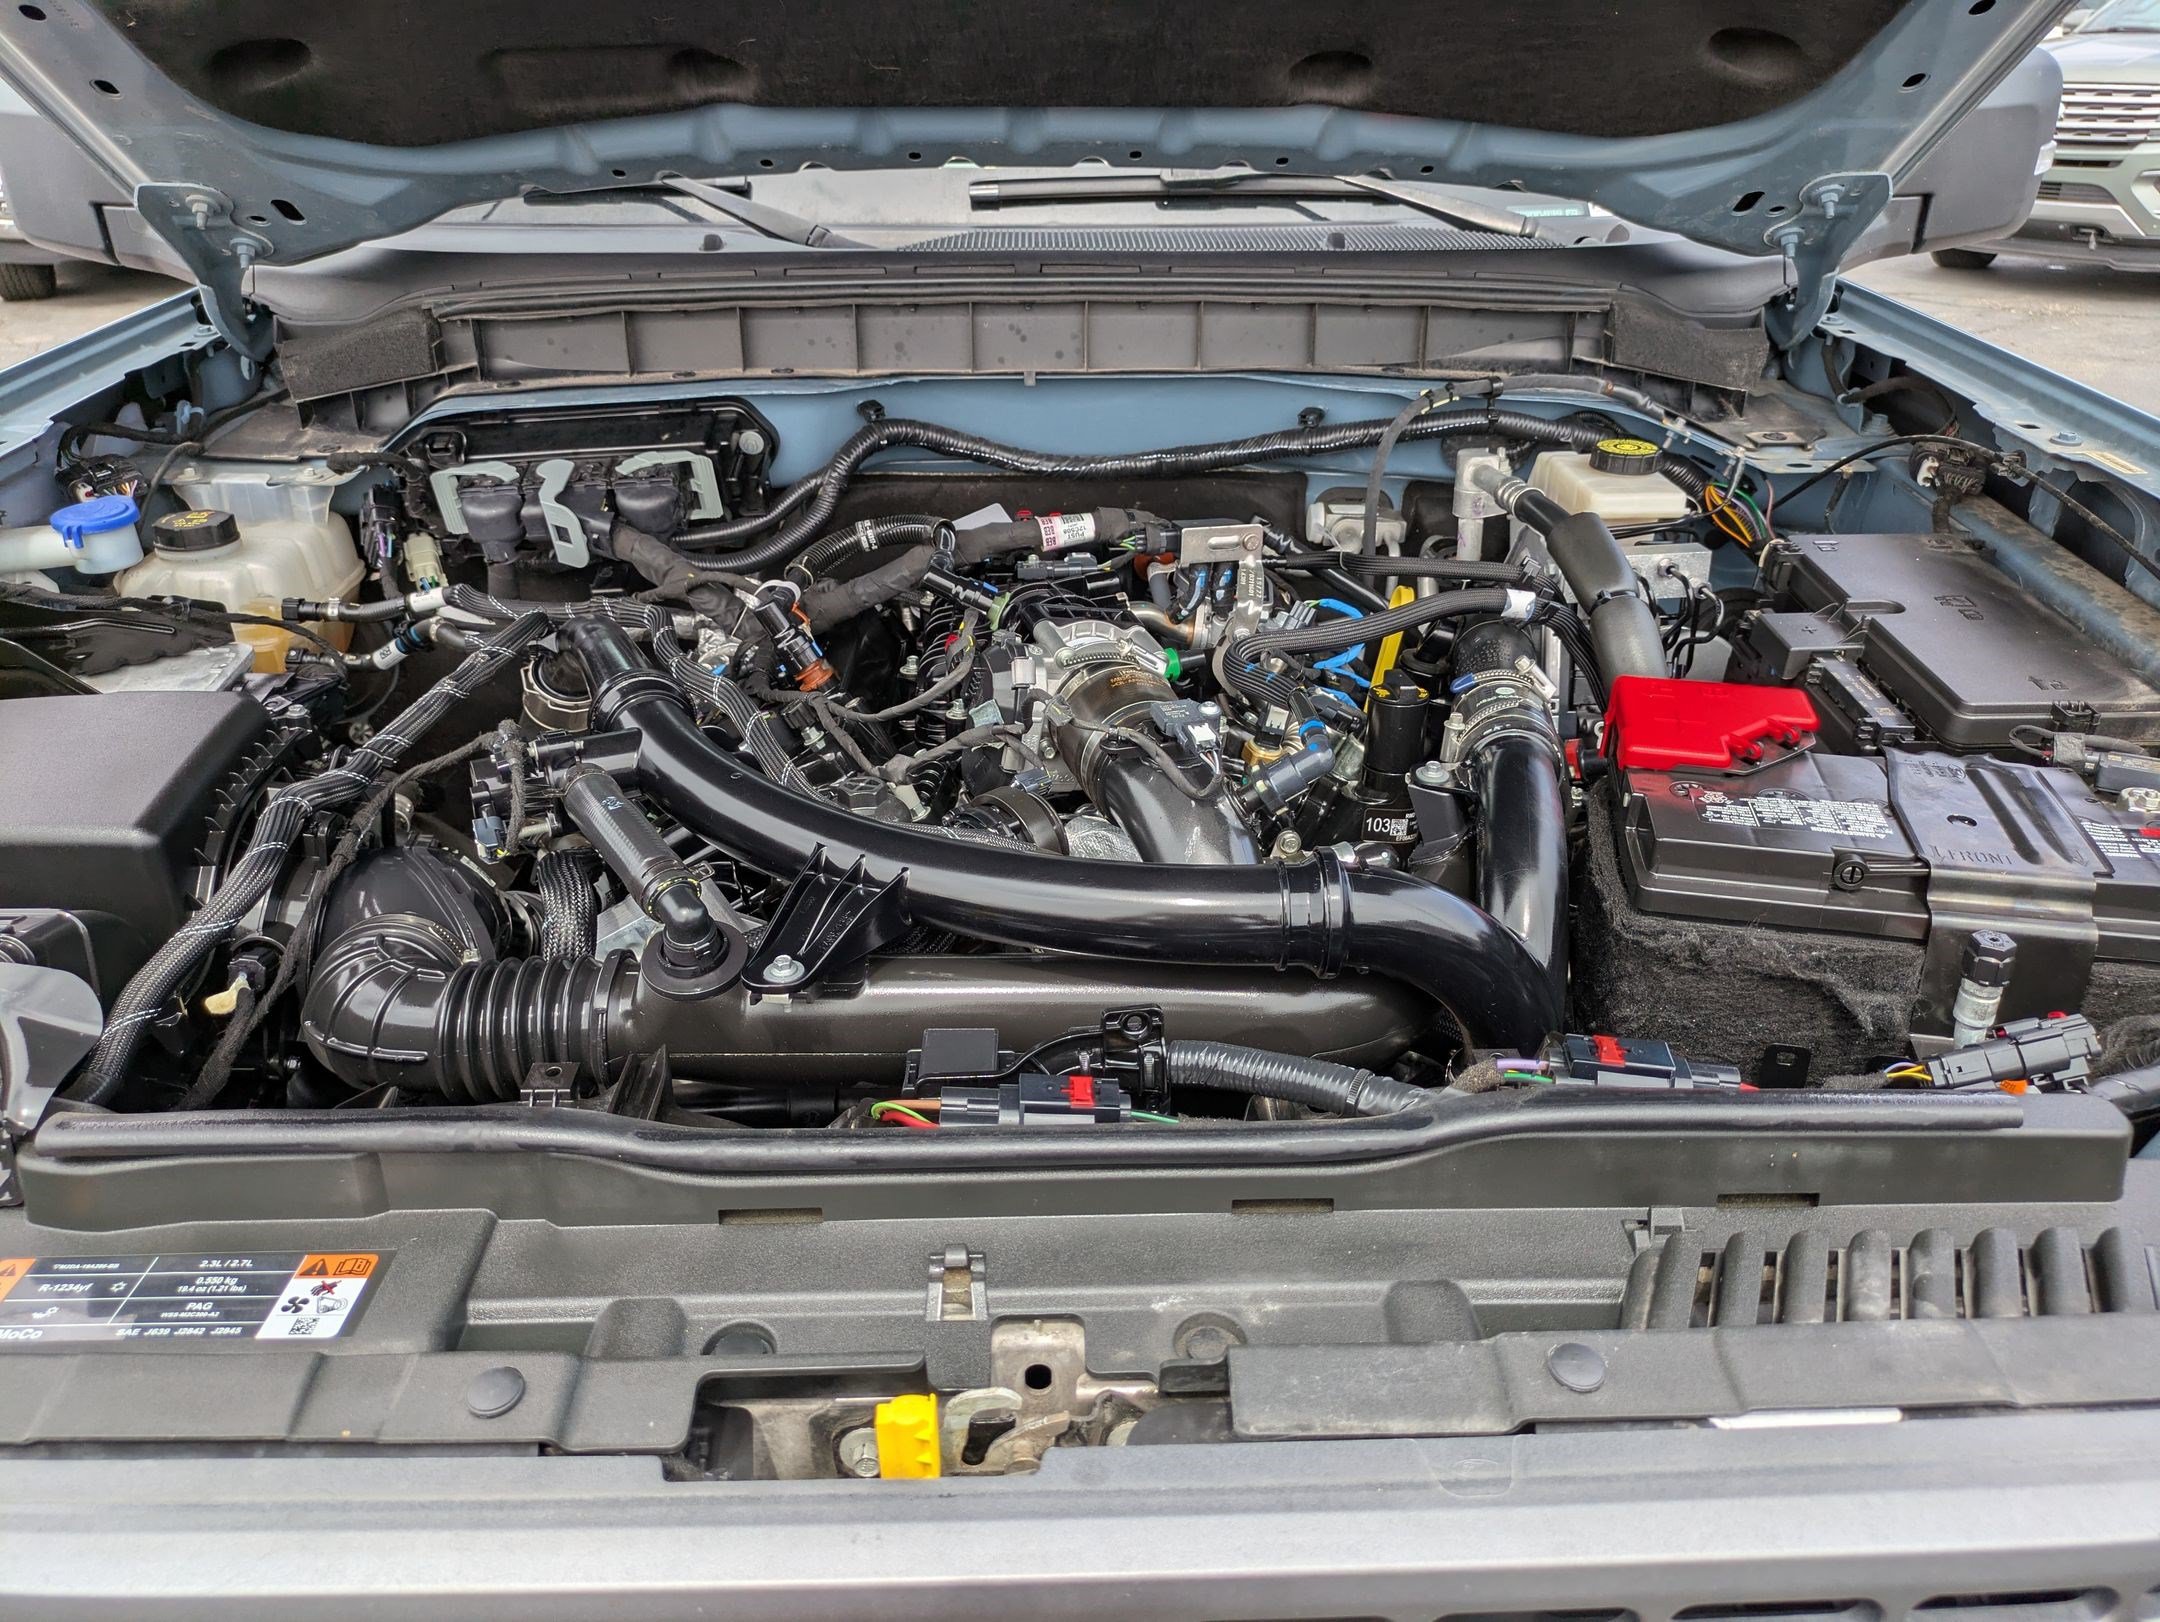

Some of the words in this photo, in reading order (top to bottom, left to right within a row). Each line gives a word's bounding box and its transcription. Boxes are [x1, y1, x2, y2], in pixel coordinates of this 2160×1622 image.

[1366, 816, 1390, 832] 103
[1947, 848, 2013, 865] FRONT
[230, 1259, 254, 1267] 2.7L
[195, 1276, 224, 1285] 0.550
[225, 1276, 238, 1286] kg
[38, 1282, 94, 1293] R-1234yf
[207, 1285, 229, 1294] (1.21
[230, 1285, 247, 1293] lbs)
[185, 1302, 214, 1311] PAG
[116, 1328, 141, 1336] SAE
[144, 1328, 171, 1336] J639
[174, 1327, 206, 1336] J2842
[210, 1326, 243, 1335] J2845
